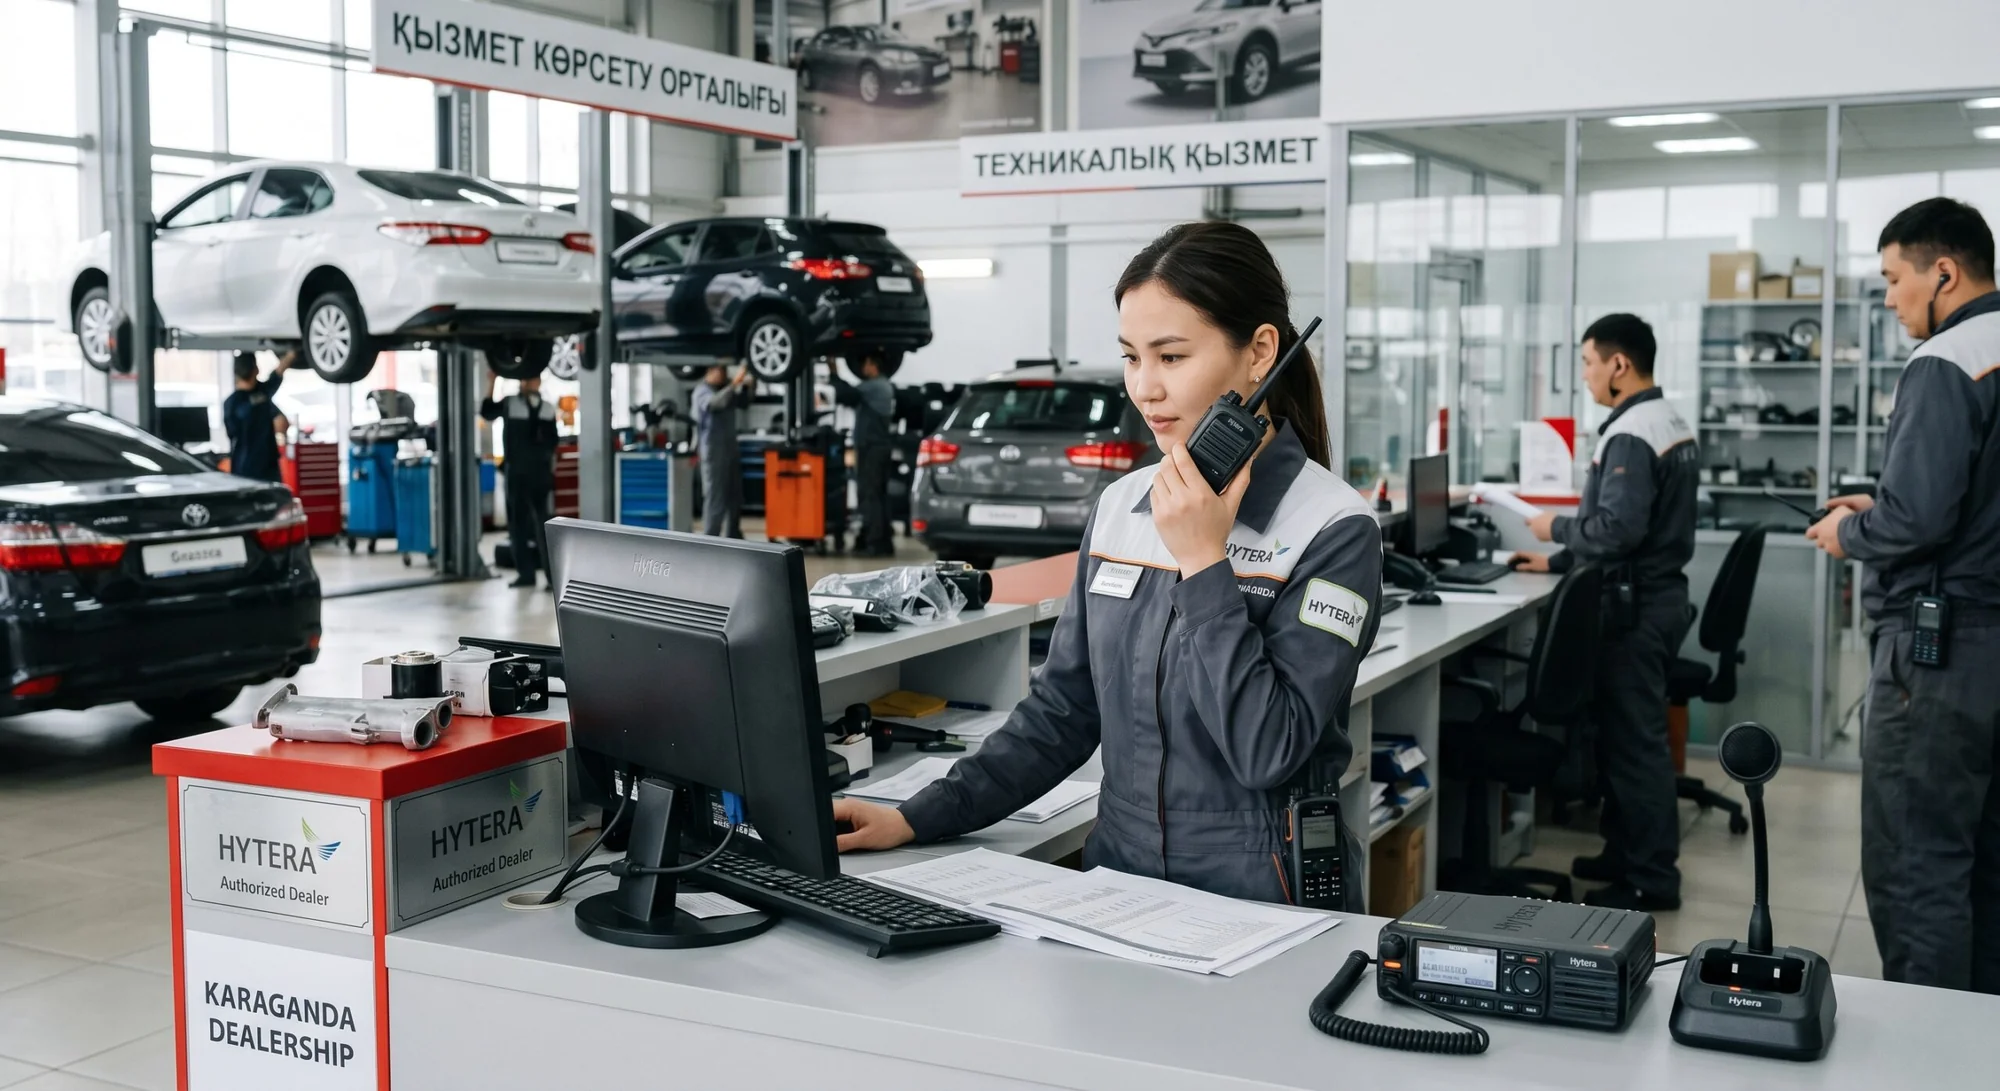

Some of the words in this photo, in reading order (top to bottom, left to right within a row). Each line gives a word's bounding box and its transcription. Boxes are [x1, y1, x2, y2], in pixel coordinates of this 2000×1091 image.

[393, 12, 524, 67] ҚЫЗМЕТ
[534, 43, 653, 91] КӨРСЕТУ
[660, 66, 787, 117] ОРТАЛЫҒЫ
[974, 143, 1176, 177] ТЕХНИКАЛЫҚ
[1185, 137, 1319, 174] ҚЫЗМЕТ
[1308, 599, 1355, 628] HYTERA
[431, 805, 524, 858] HYTERA
[219, 833, 317, 874] HYTERA
[432, 857, 496, 893] Authorized
[498, 848, 533, 870] Dealer
[220, 875, 285, 899] Authorized
[289, 886, 329, 906] Dealer
[1570, 957, 1597, 968] Hytera
[204, 980, 356, 1032] KARAGANDA
[1728, 996, 1762, 1008] Hytera
[209, 1017, 354, 1068] DEALERSHIP
